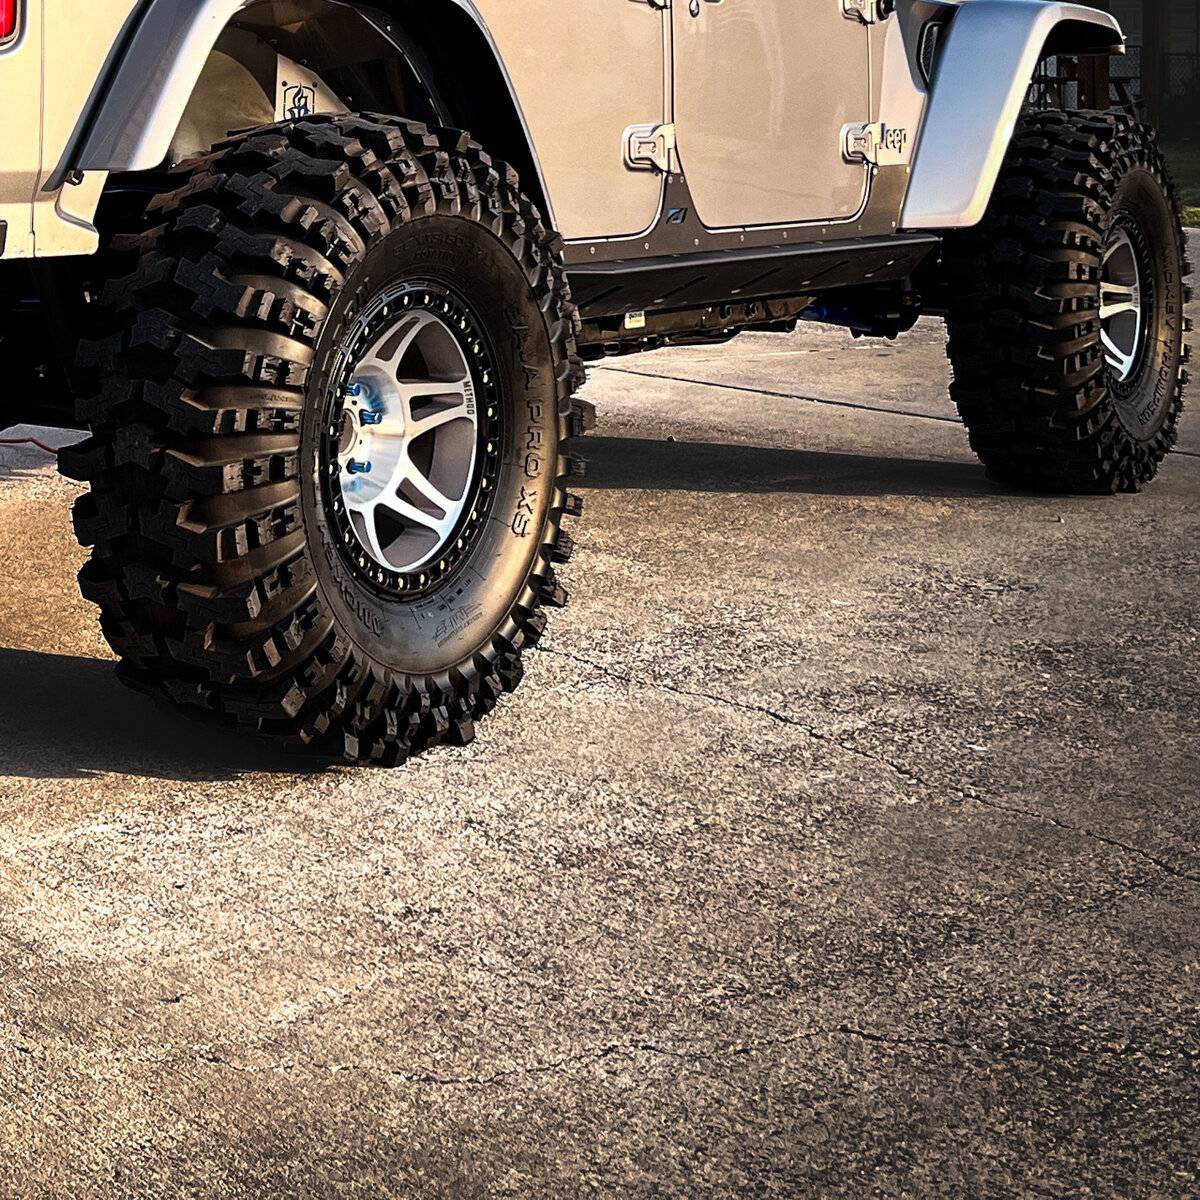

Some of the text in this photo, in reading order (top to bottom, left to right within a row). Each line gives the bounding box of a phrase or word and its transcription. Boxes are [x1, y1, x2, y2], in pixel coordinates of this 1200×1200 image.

[463, 380, 476, 416] METHOD
[522, 399, 543, 479] PRO
[509, 484, 538, 539] XS
